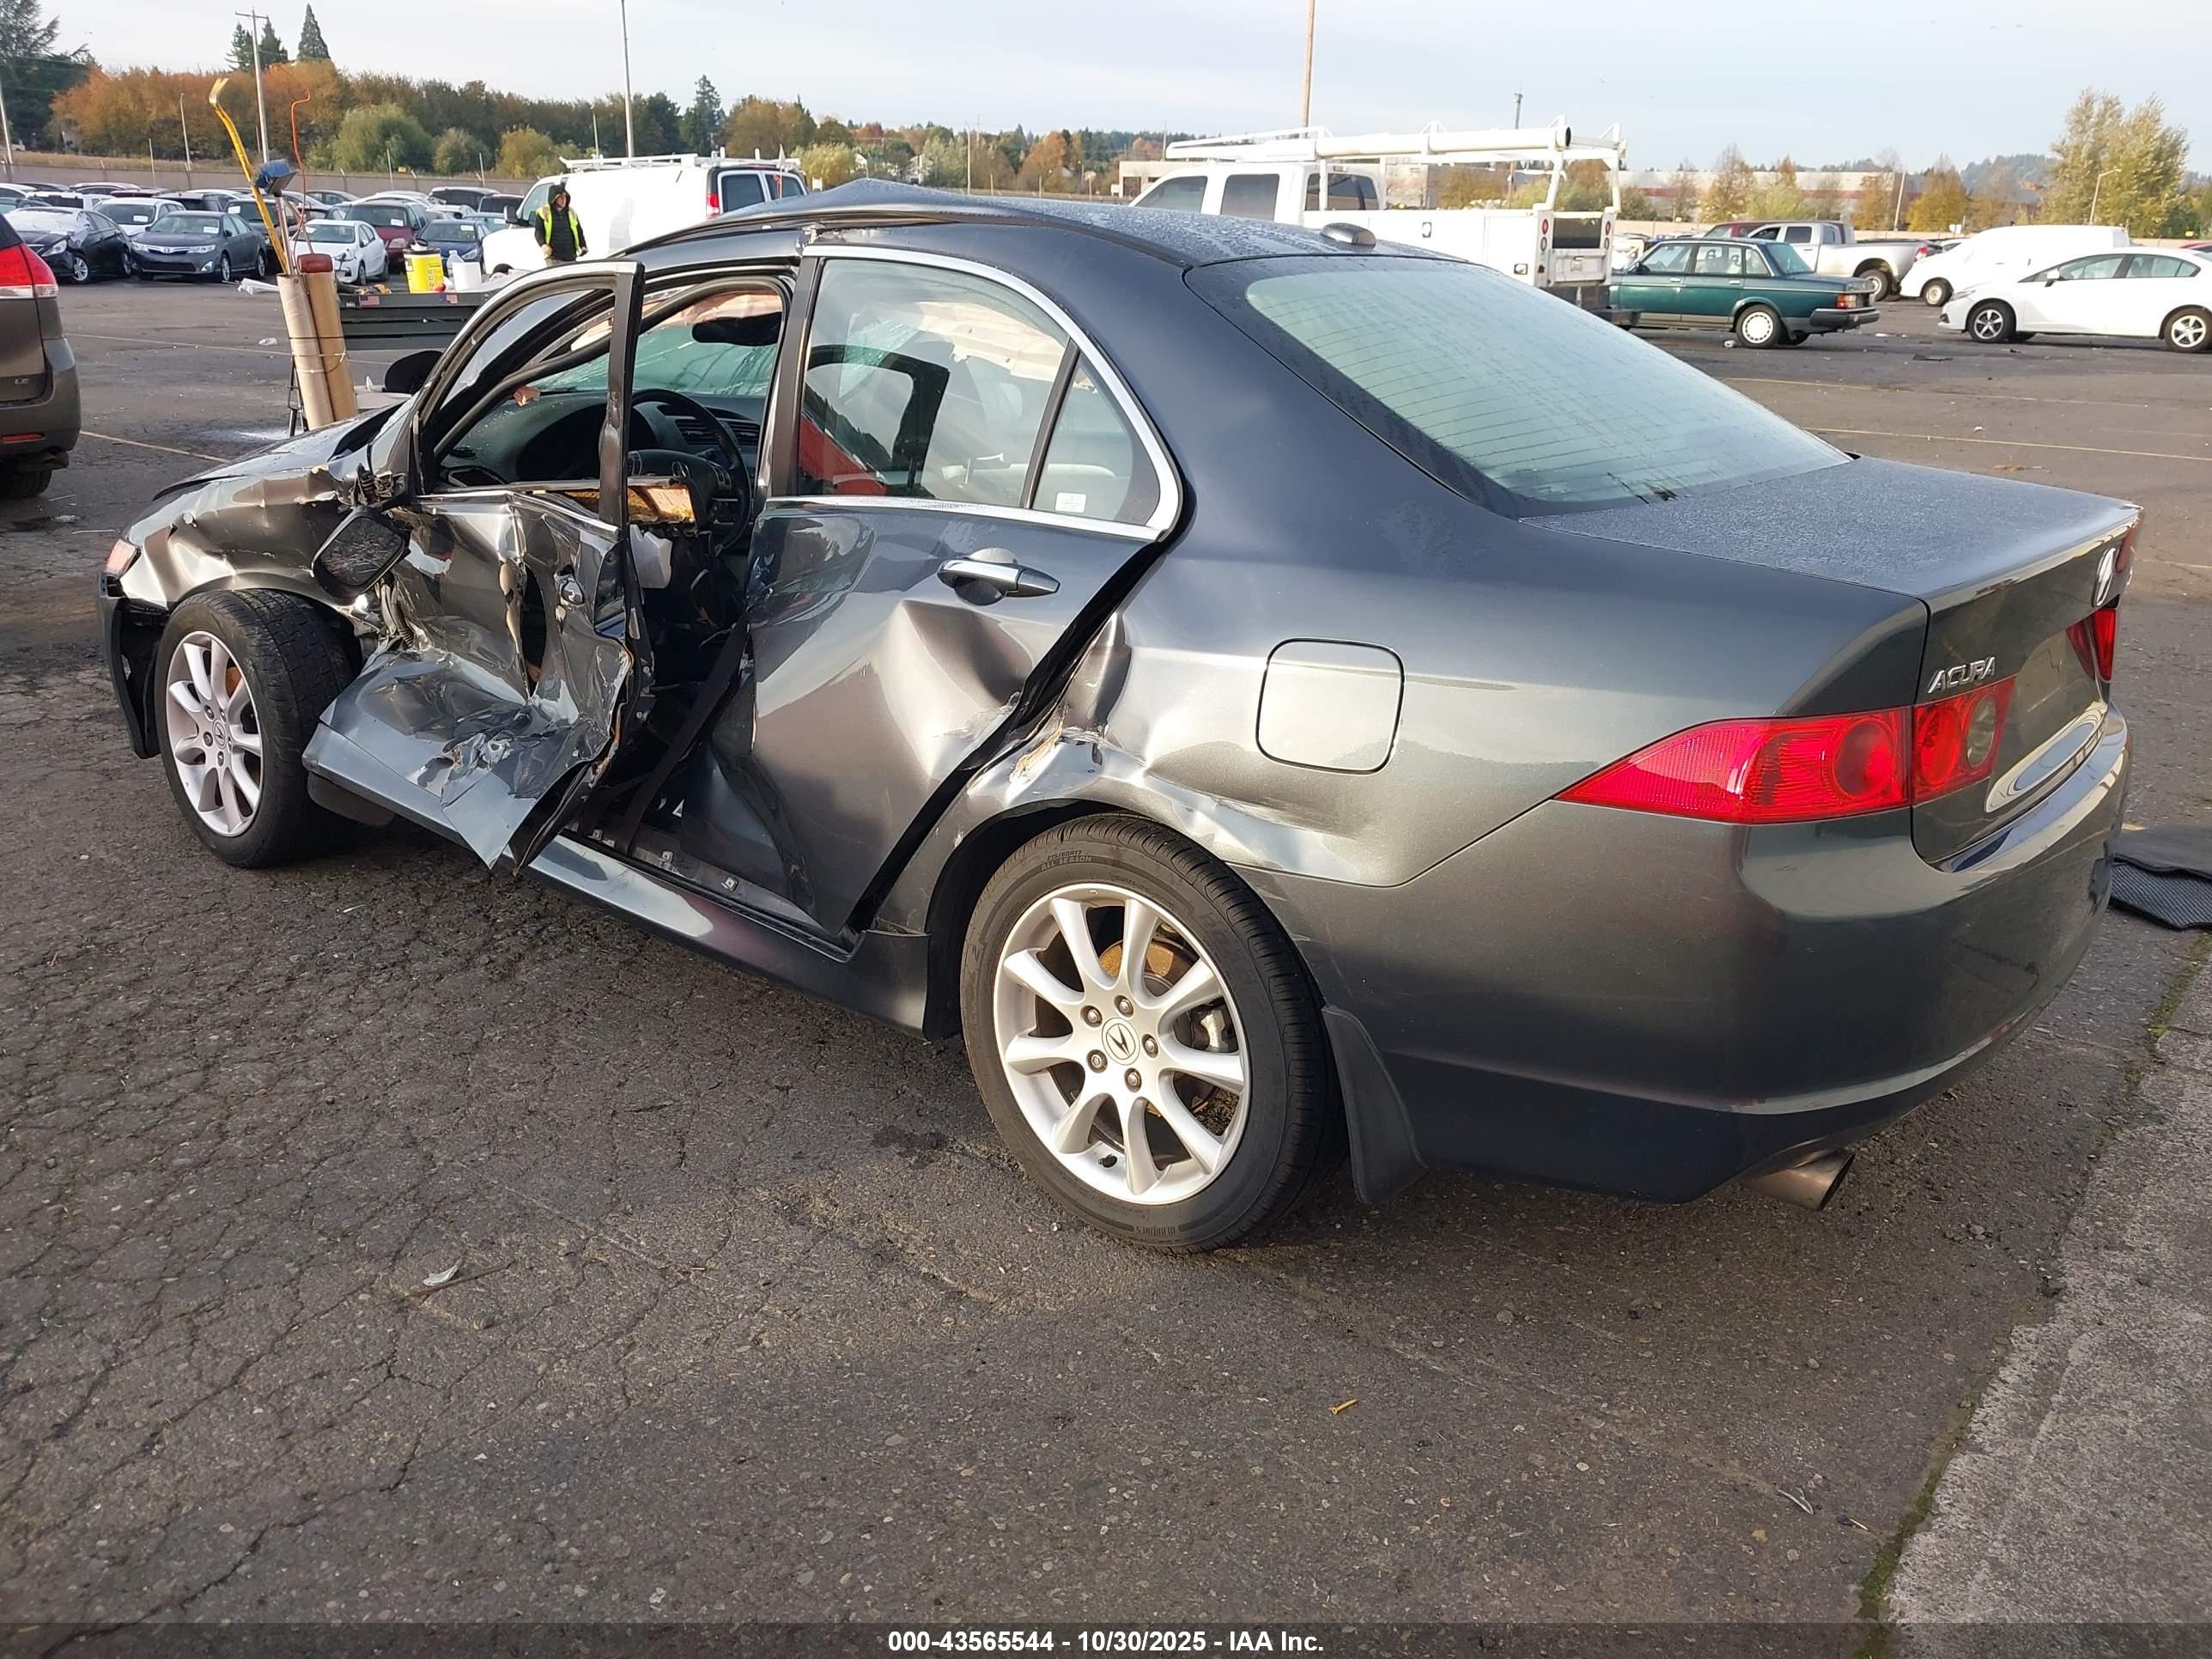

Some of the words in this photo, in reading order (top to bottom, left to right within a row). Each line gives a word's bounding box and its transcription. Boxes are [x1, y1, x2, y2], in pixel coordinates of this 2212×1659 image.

[1927, 657, 1995, 693] ACURA
[1041, 860, 1056, 871] ALL
[1059, 854, 1093, 865] SEASON
